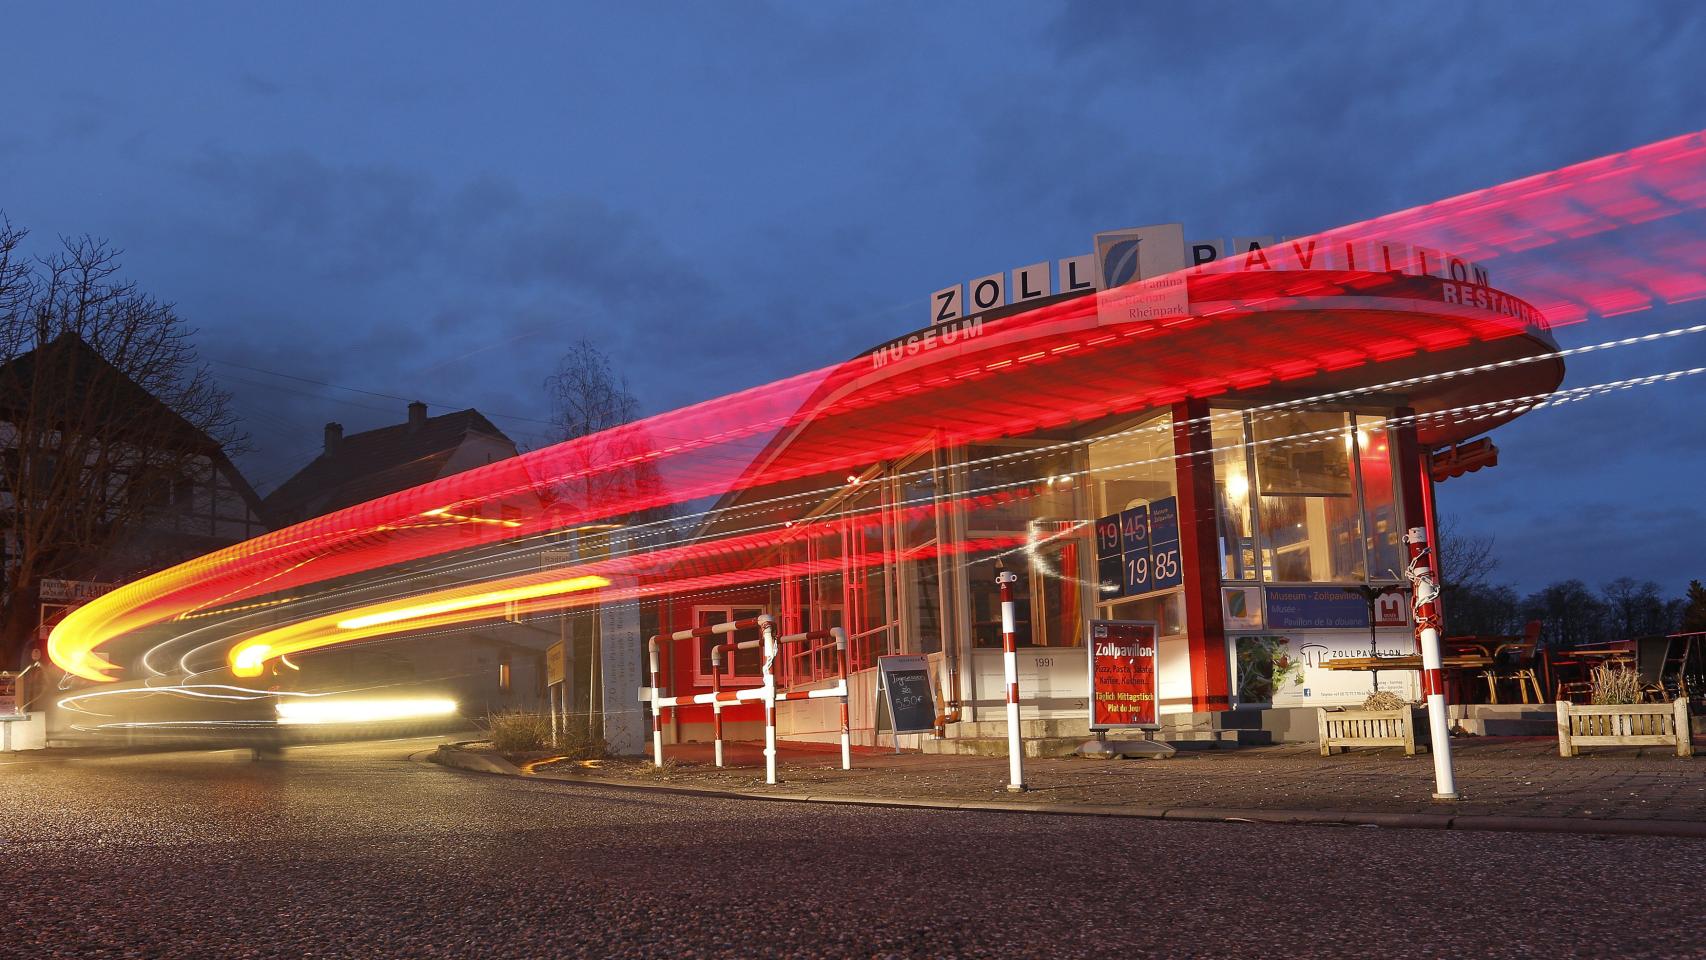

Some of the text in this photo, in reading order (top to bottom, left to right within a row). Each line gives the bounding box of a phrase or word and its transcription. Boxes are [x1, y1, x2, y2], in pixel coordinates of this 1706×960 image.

[936, 262, 1090, 322] ZOLL
[1443, 282, 1551, 329] RESTAURAN
[1128, 304, 1184, 319] Rheinpark
[872, 316, 983, 369] MUSEUM
[1270, 592, 1306, 600] Museum
[1314, 591, 1363, 602] Zollpavillon
[1271, 604, 1296, 613] Musée
[1284, 617, 1363, 627] Pavillon de la douane
[1332, 649, 1401, 658] ZOLLPAVLLON
[1034, 657, 1054, 668] 1991
[1095, 691, 1116, 703] Täglich
